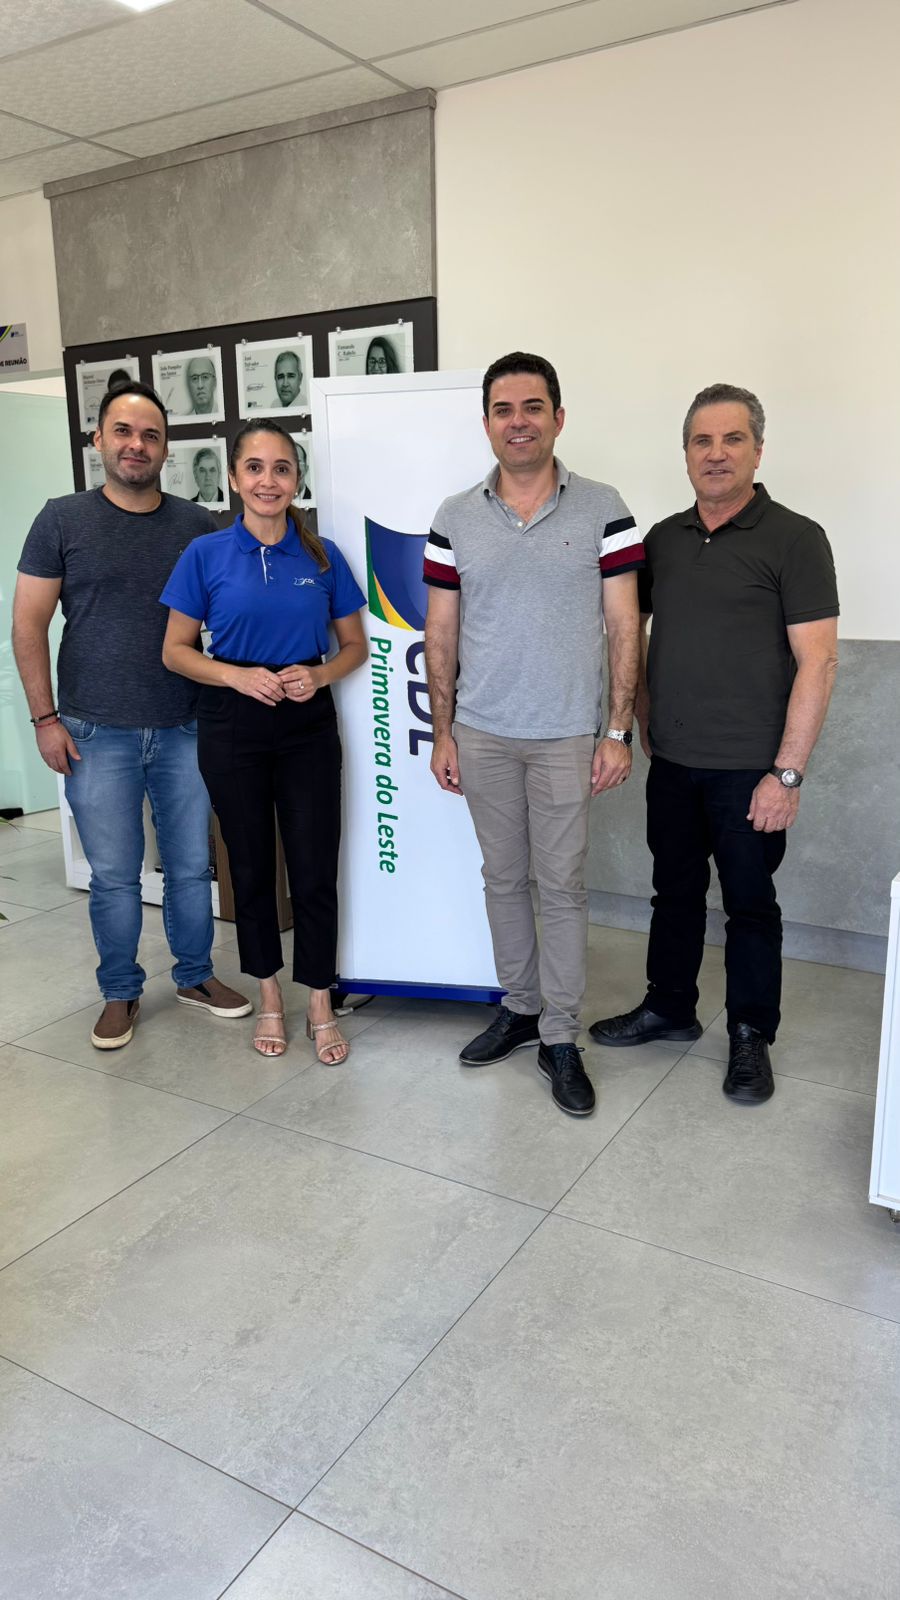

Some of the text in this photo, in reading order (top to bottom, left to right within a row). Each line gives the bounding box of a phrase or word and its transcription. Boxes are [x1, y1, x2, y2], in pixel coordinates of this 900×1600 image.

[5, 357, 28, 366] REUNIÃO
[370, 637, 399, 874] Primavera do Leste
